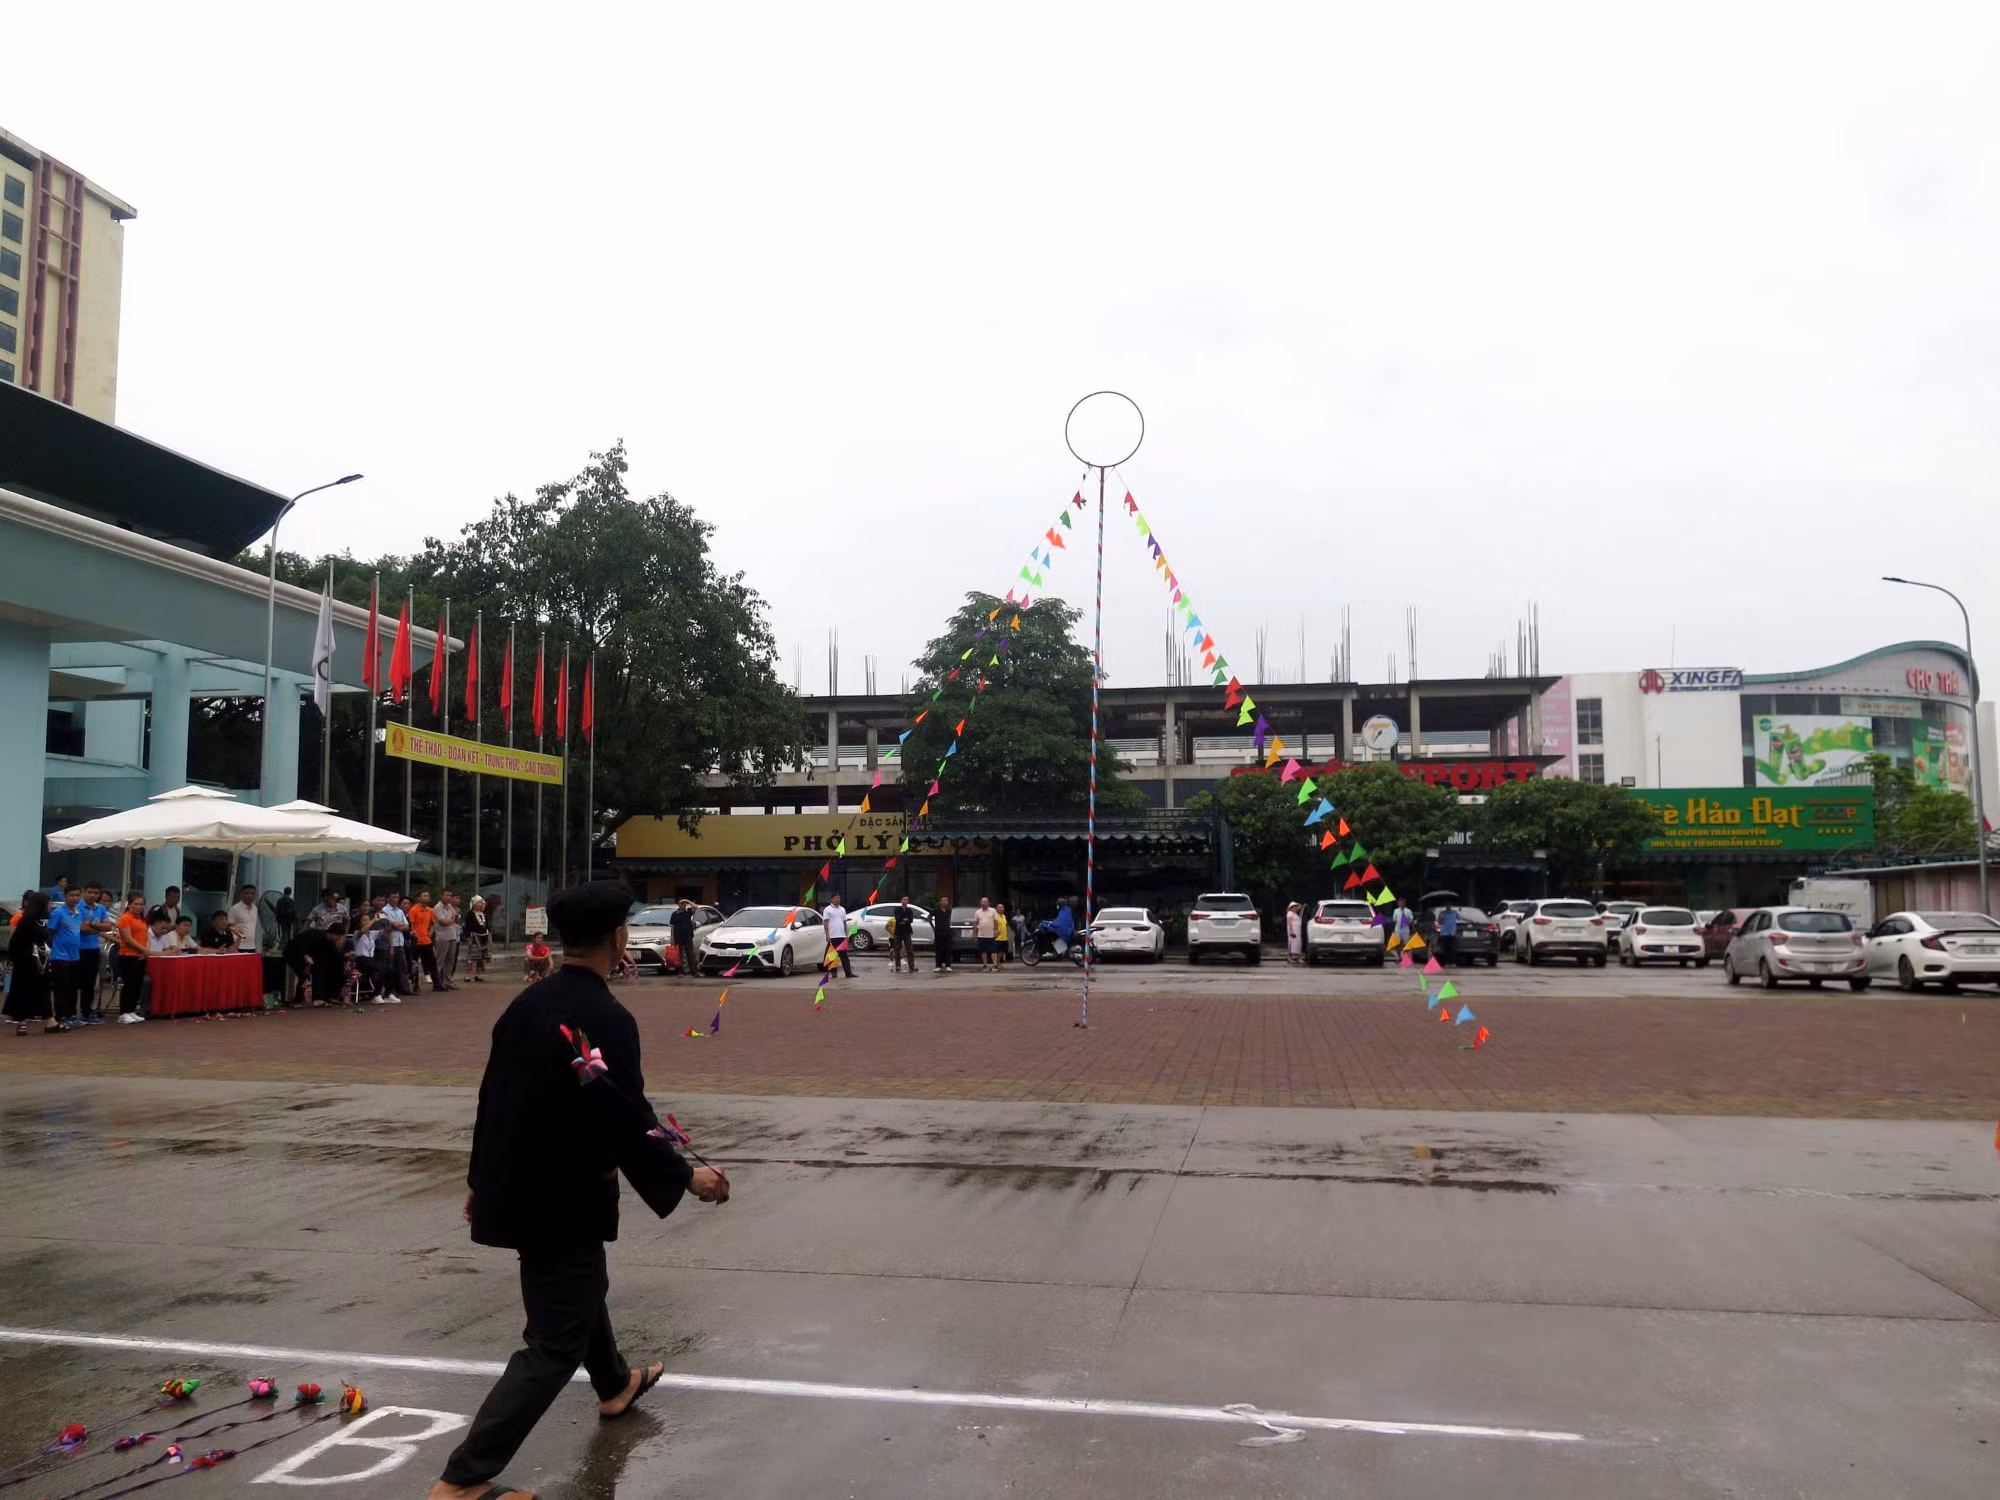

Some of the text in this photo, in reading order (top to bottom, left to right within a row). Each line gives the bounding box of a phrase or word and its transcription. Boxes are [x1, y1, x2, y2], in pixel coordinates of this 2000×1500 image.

[1670, 671, 1744, 685] XINGFA
[1398, 761, 1537, 792] SPORT
[783, 829, 846, 851] PHỞ
[855, 830, 893, 850] LÝ
[250, 1405, 470, 1485] B
